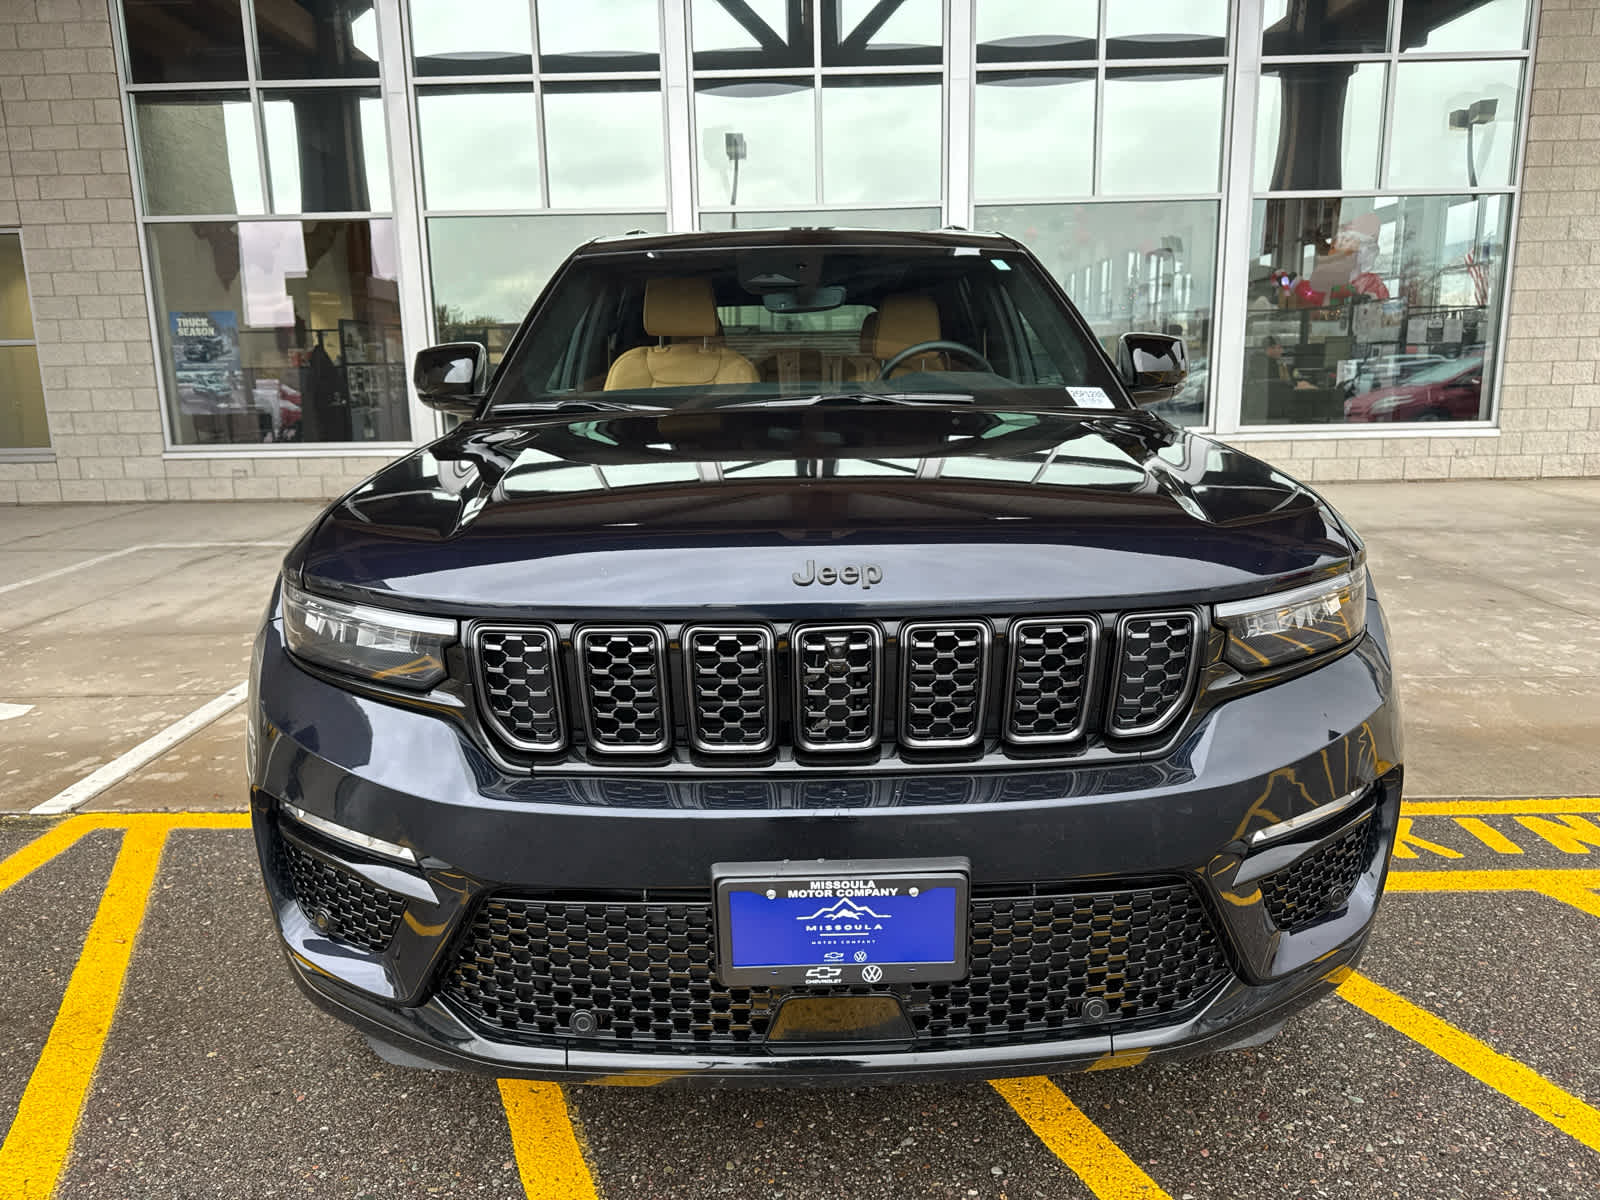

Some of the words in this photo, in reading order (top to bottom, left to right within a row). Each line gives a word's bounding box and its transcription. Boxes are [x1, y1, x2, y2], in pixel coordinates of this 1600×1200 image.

[176, 318, 208, 327] TRUCK
[177, 327, 214, 336] SEASON
[791, 559, 883, 590] Jeep
[810, 880, 876, 889] MISSOULA
[787, 890, 833, 898] MOTOR
[836, 888, 899, 897] COMPANY
